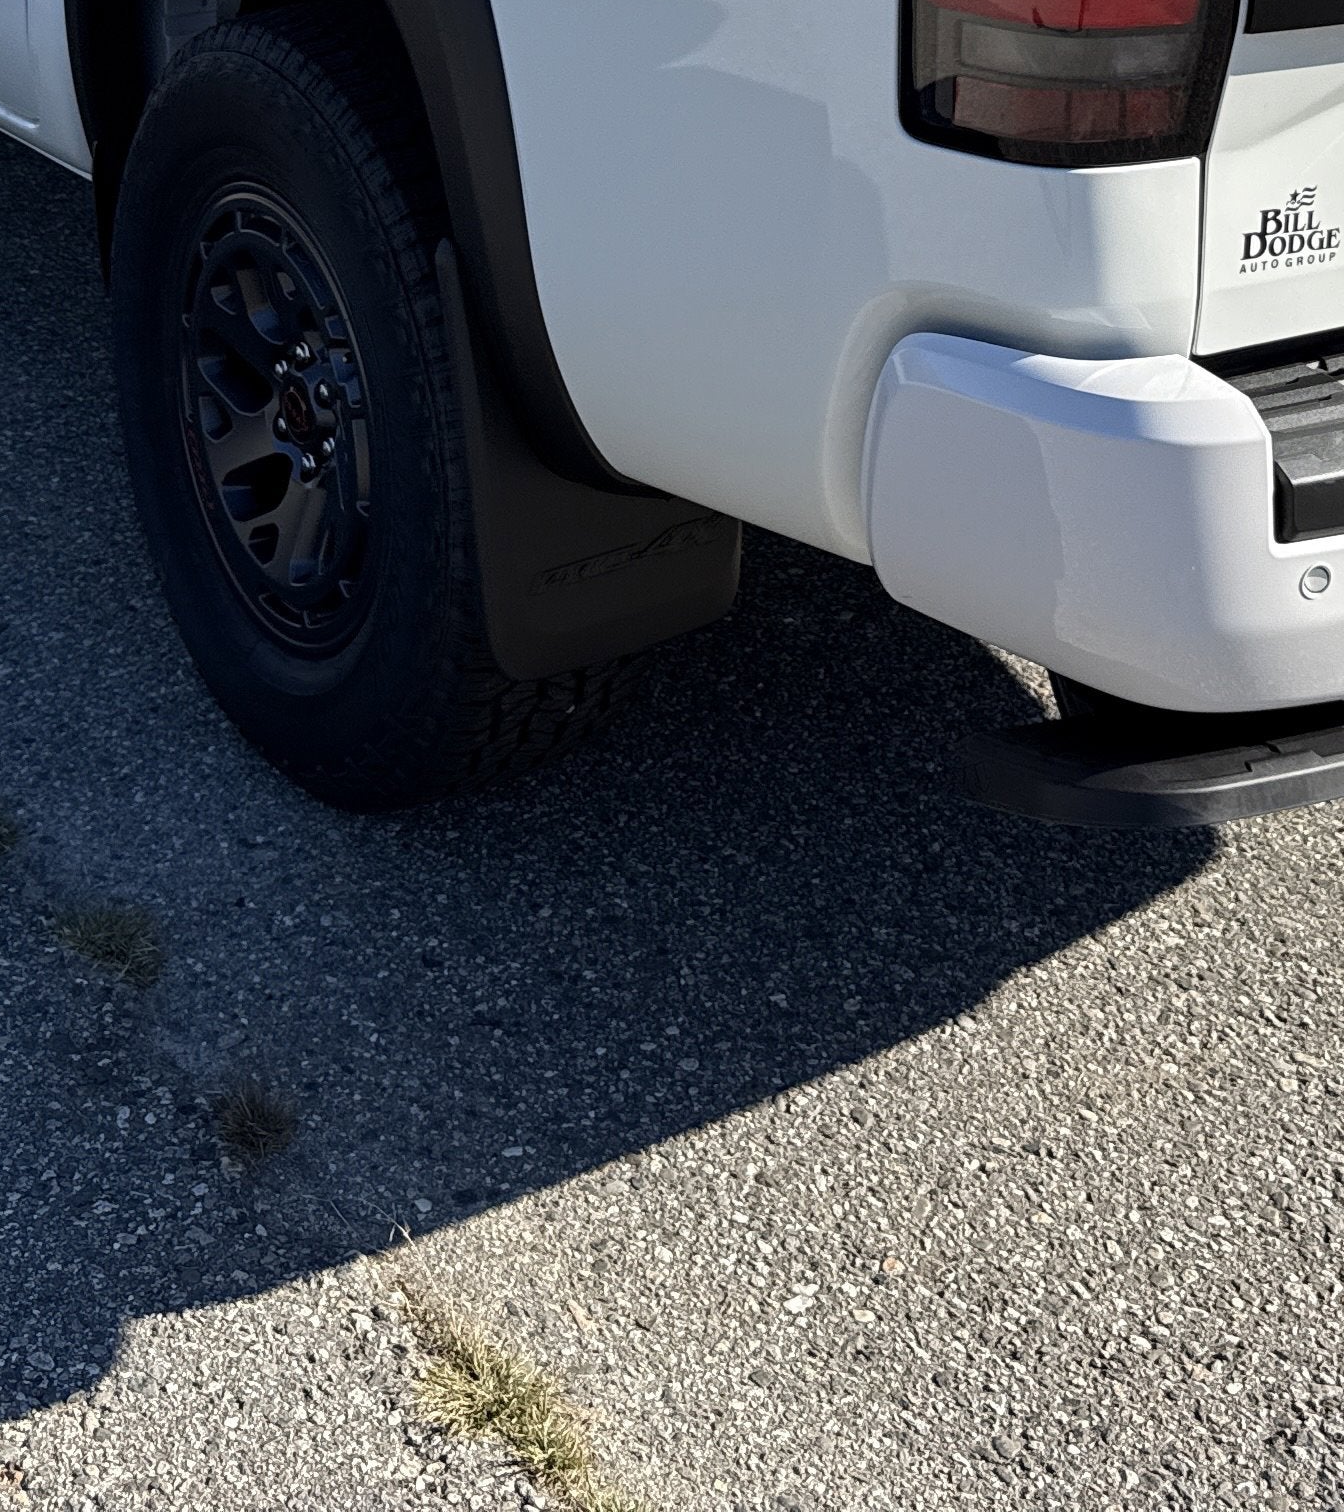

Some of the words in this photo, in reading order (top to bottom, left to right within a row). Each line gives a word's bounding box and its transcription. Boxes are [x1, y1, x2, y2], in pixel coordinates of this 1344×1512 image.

[1240, 227, 1341, 261] DODGE
[1239, 258, 1279, 274] AUTO
[1285, 251, 1337, 268] GROUP
